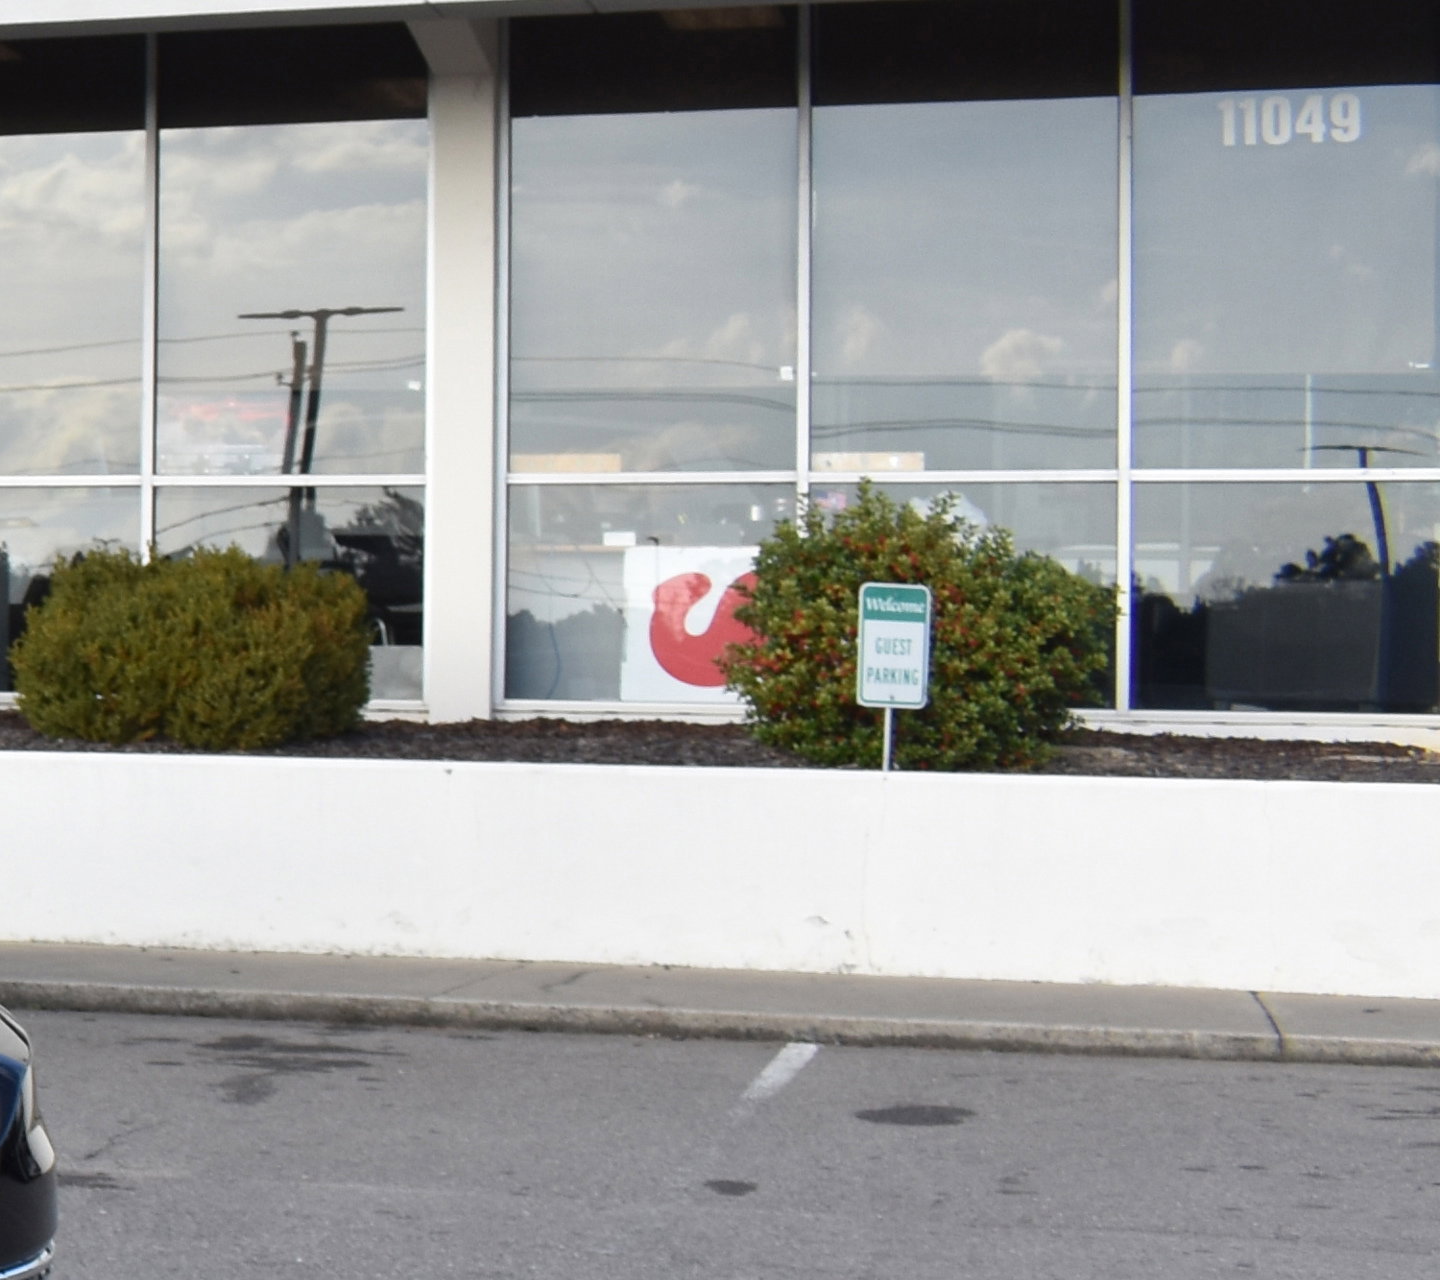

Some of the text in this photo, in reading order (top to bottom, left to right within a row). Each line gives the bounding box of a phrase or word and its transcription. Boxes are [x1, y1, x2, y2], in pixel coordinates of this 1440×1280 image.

[1218, 93, 1362, 147] 11049
[865, 596, 925, 613] Welcome
[875, 637, 912, 656] GUEST
[867, 667, 920, 686] PARKING
